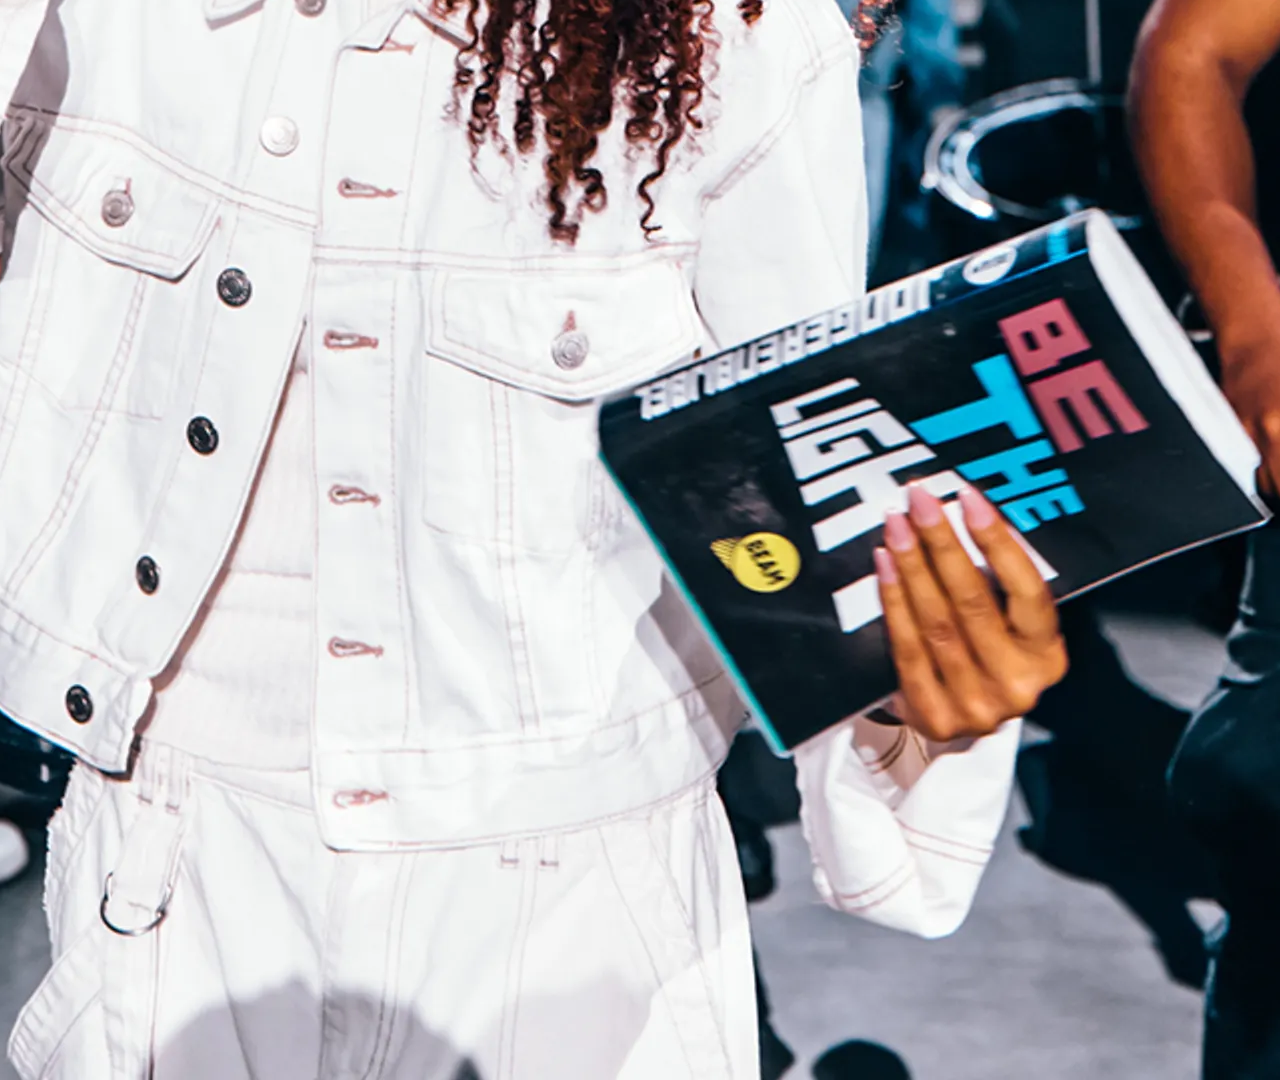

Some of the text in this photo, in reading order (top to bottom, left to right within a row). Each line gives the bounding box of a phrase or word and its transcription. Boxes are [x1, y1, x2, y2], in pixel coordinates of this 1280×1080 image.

[910, 354, 1085, 532] THE
[998, 298, 1148, 453] BE
[746, 540, 786, 585] BEAM
